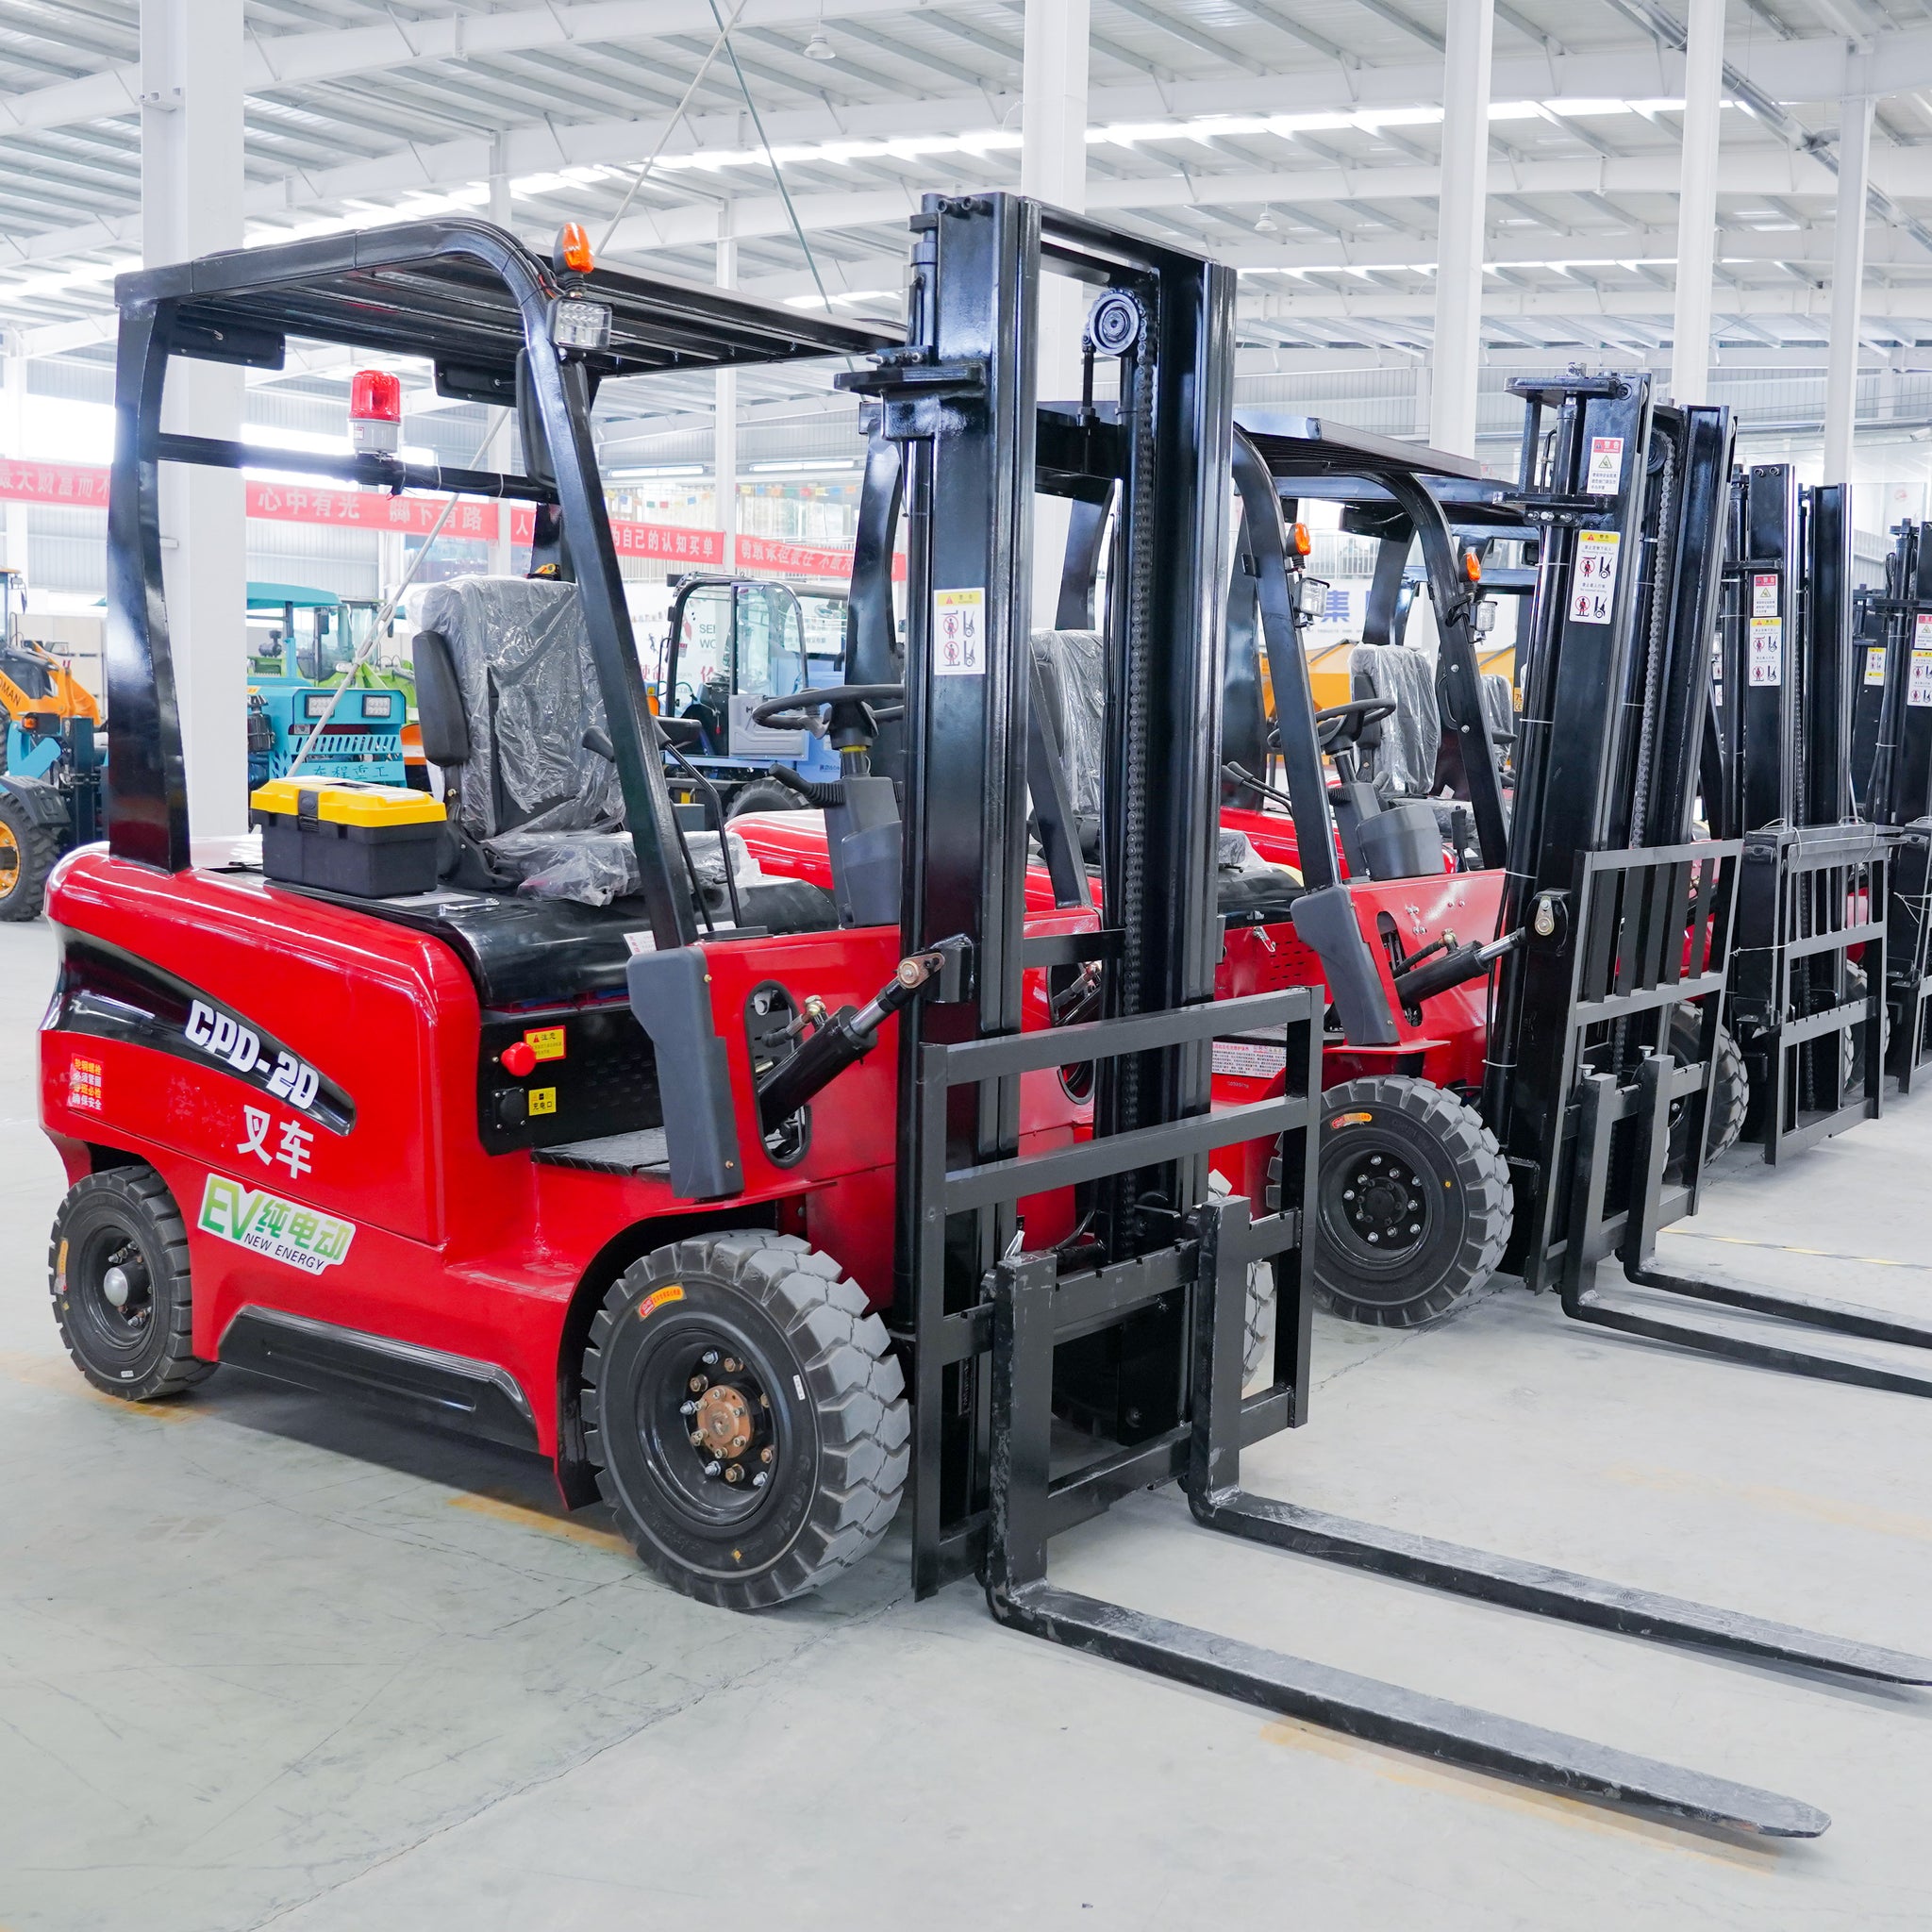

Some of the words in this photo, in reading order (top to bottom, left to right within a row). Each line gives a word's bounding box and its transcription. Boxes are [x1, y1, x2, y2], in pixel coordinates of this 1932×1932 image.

[258, 487, 360, 520] 心中有光
[237, 1104, 314, 1179] 叉车
[243, 1232, 273, 1252] NEW
[275, 1244, 325, 1271] ENERGY
